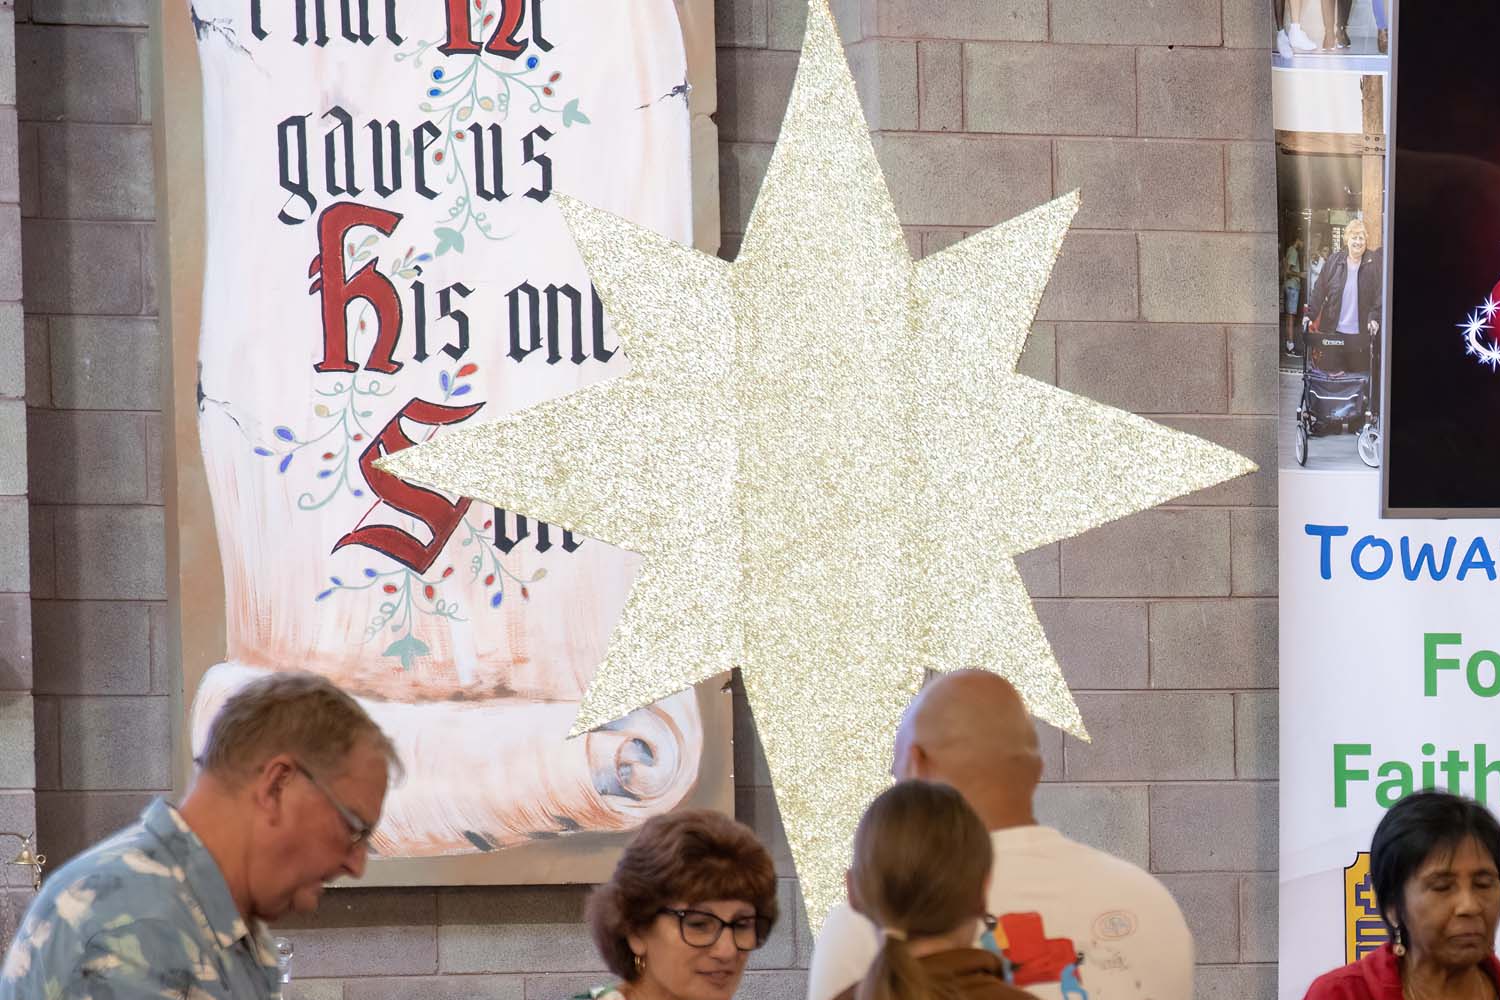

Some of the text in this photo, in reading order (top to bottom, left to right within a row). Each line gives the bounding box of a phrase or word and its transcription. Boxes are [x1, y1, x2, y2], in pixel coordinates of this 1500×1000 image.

[277, 106, 558, 225] gave us
[308, 202, 629, 374] His onl
